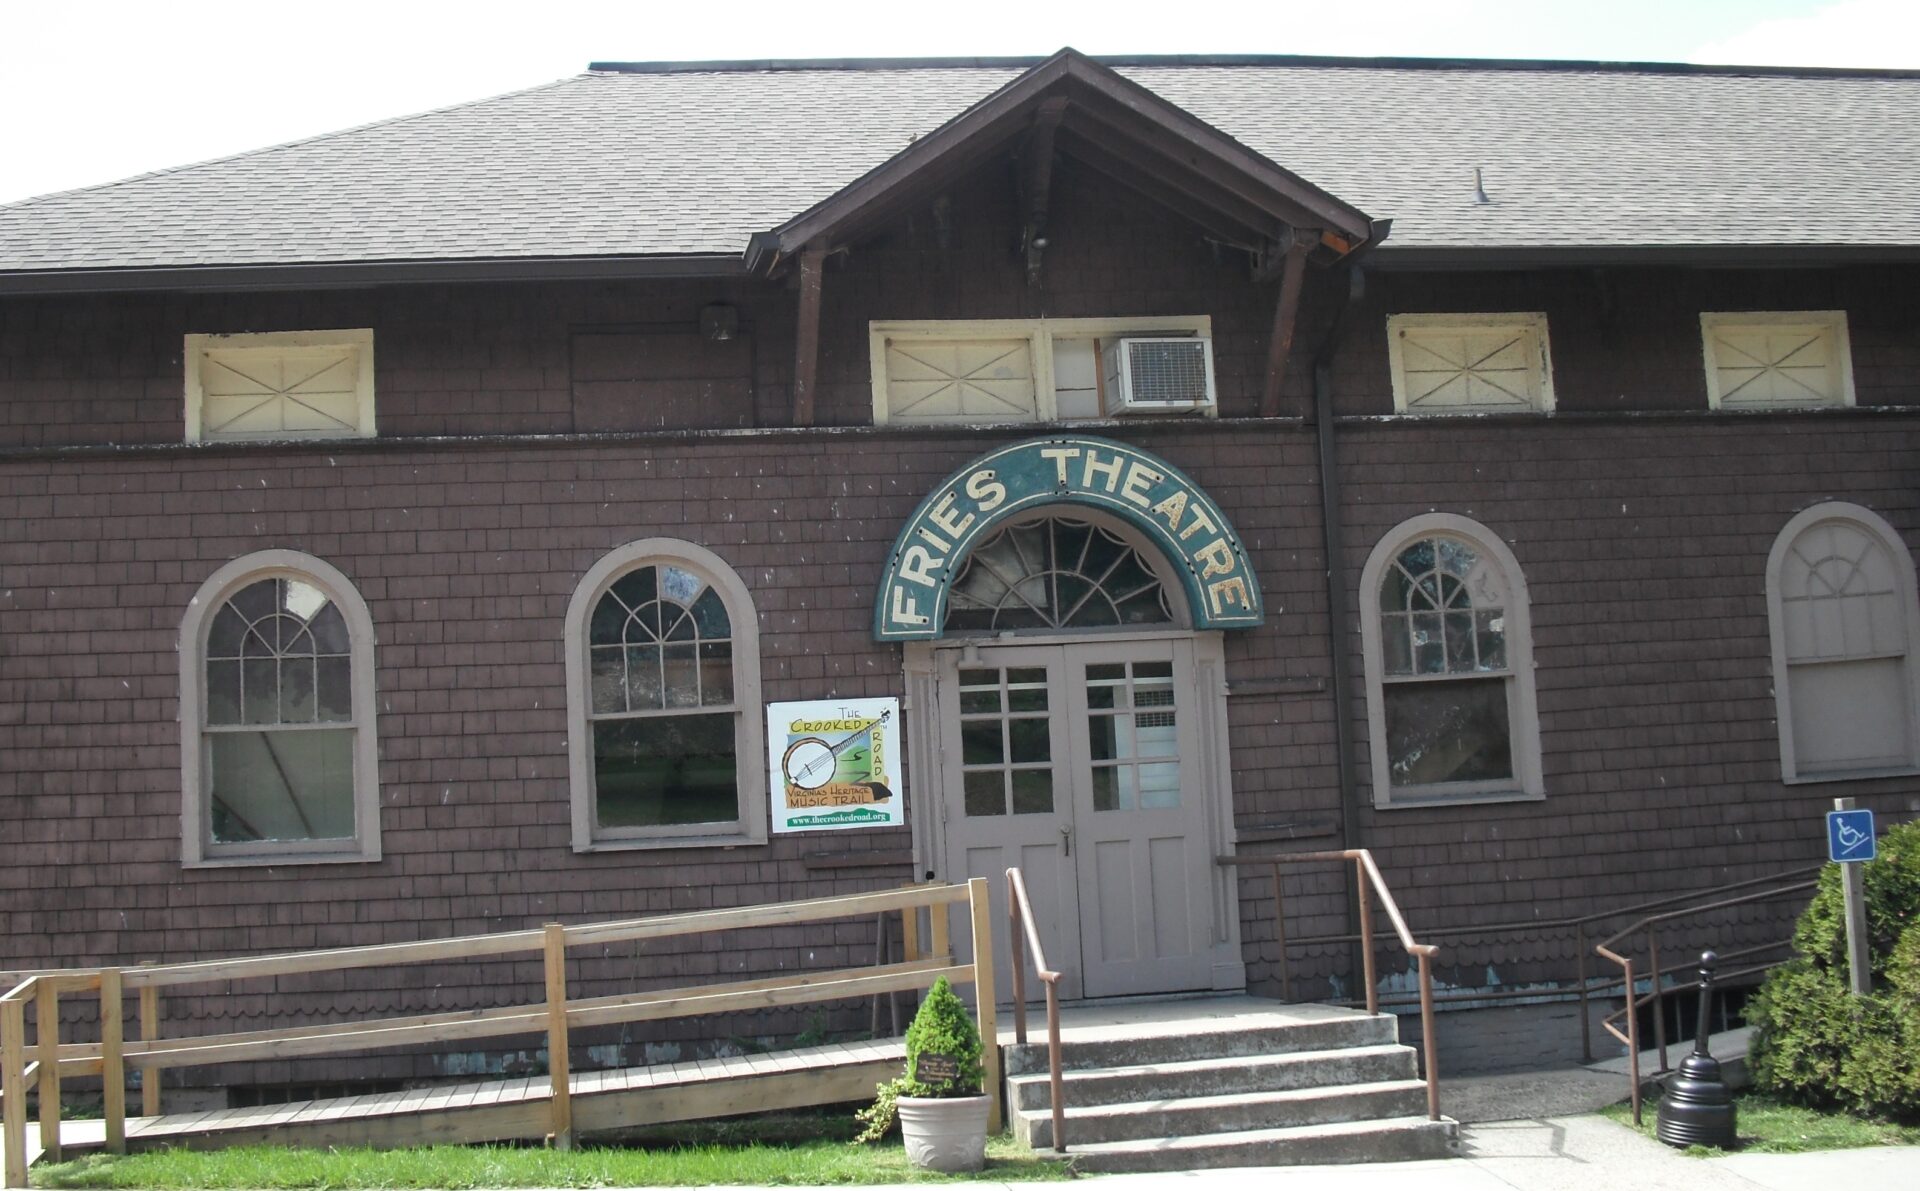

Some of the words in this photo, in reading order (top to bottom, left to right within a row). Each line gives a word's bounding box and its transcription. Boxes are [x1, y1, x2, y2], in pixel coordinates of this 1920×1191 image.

[891, 469, 1006, 624] FRIES
[1041, 448, 1251, 616] THEATRE
[838, 707, 861, 720] THE
[791, 719, 862, 733] CROOKED
[872, 732, 883, 776] ROAD
[830, 784, 870, 795] HERITAGE
[790, 797, 828, 808] MUSIC
[833, 794, 870, 805] TRAIL
[792, 813, 886, 825] www.thecrookedroad.org
